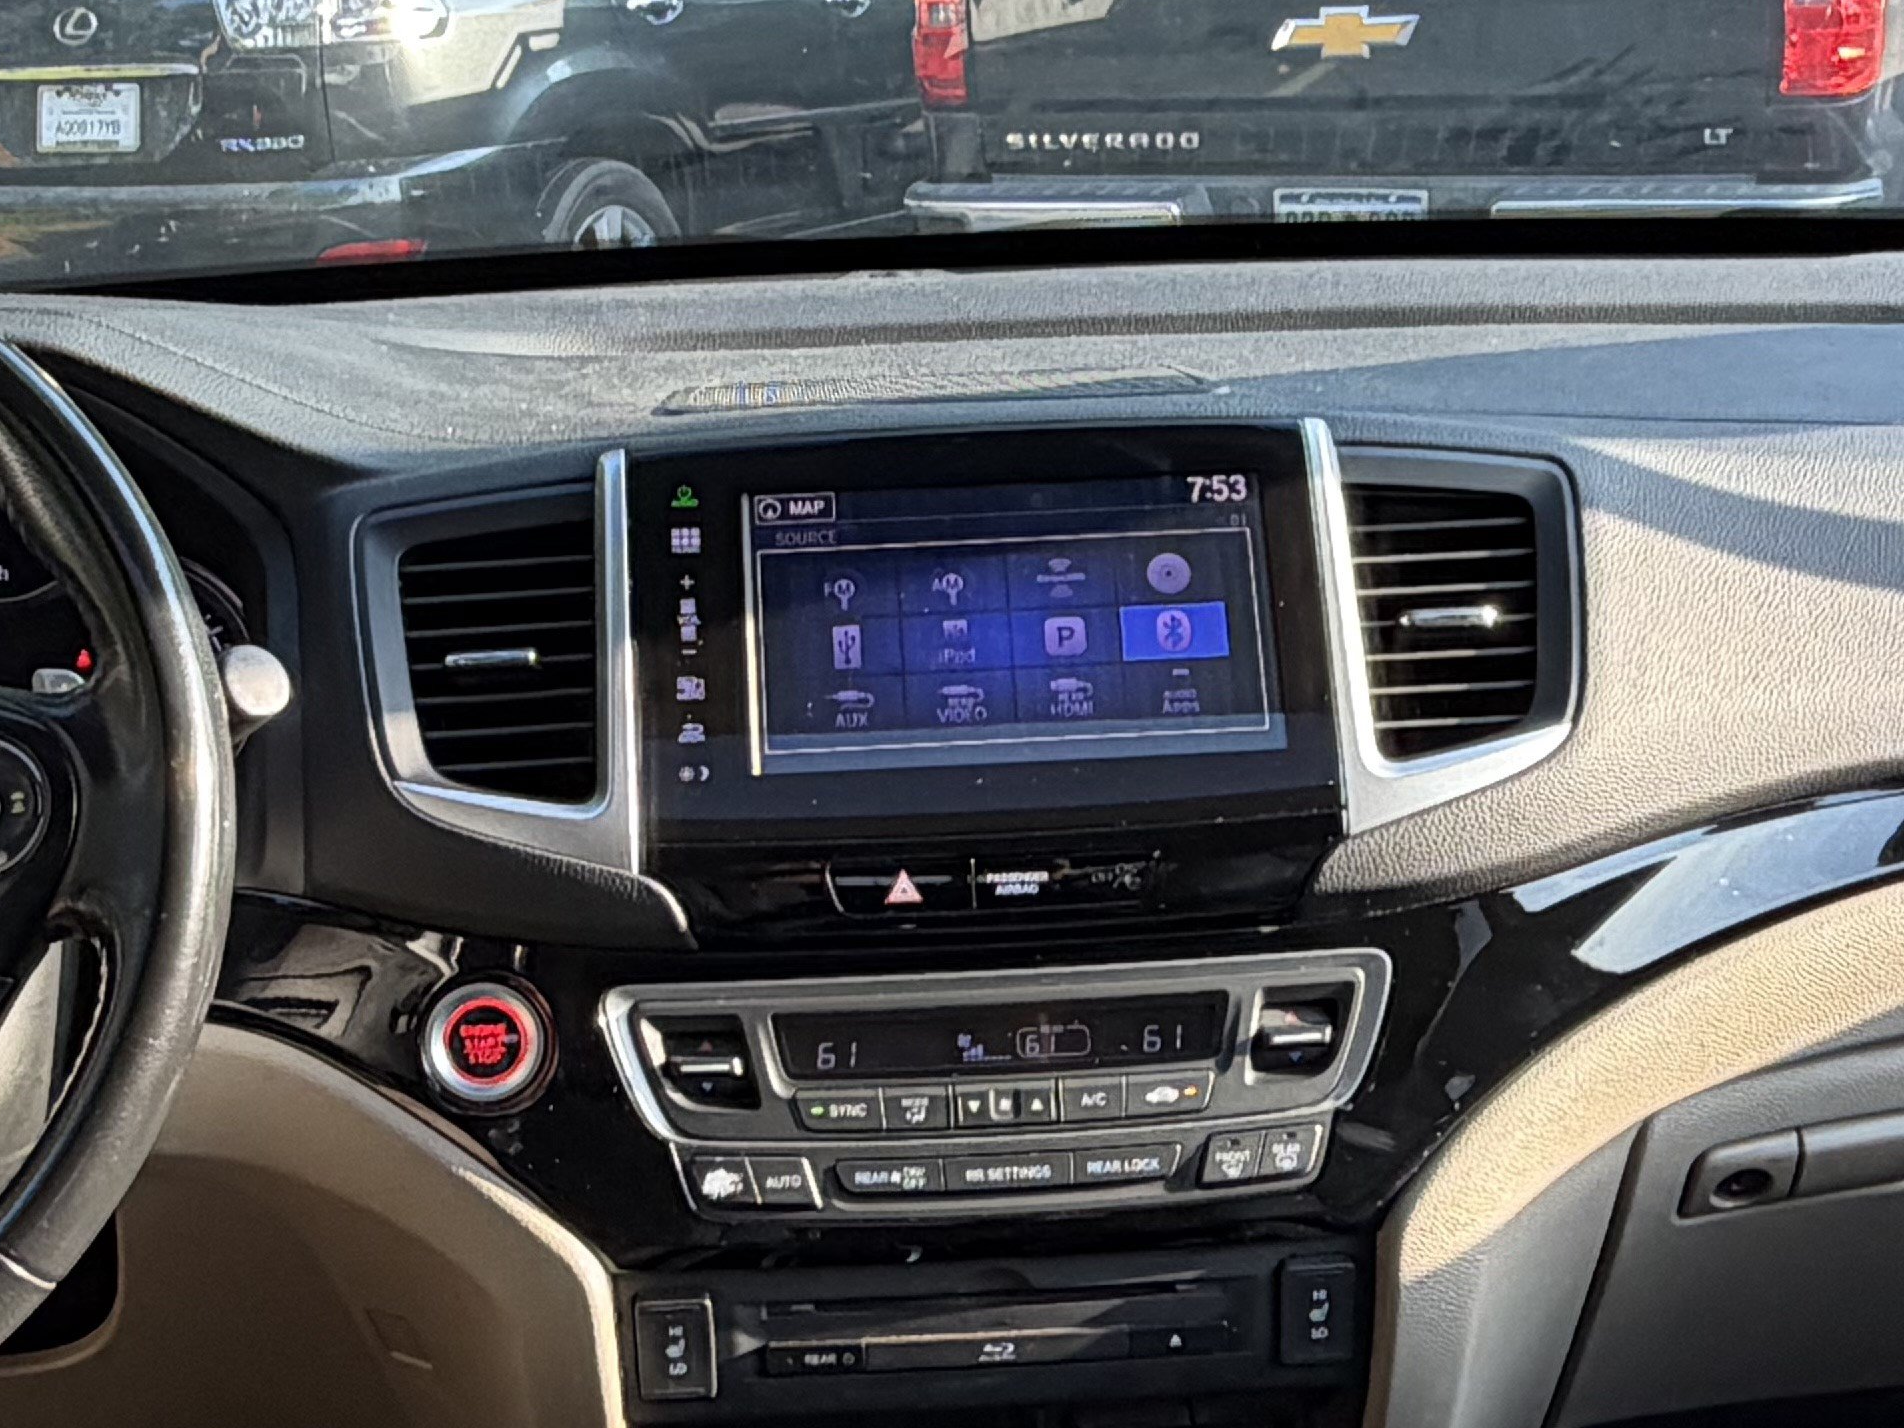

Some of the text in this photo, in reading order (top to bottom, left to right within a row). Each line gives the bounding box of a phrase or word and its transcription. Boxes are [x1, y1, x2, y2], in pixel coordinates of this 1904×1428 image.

[1006, 130, 1200, 151] SILVERADO
[1703, 127, 1734, 145] LT
[1186, 474, 1248, 503] 7:53
[788, 500, 826, 516] MAP
[775, 530, 837, 546] SOURCE
[835, 712, 868, 728] AUX
[936, 705, 988, 723] VIDEO
[1141, 1024, 1183, 1052] 61
[816, 1040, 857, 1070] 61
[1080, 1091, 1107, 1108] A/C
[829, 1102, 868, 1118] SYNC
[987, 1164, 1052, 1182] SETTINGS
[1087, 1157, 1160, 1175] REAR LOCK
[765, 1175, 802, 1188] AUTO
[804, 1353, 838, 1365] REAR
